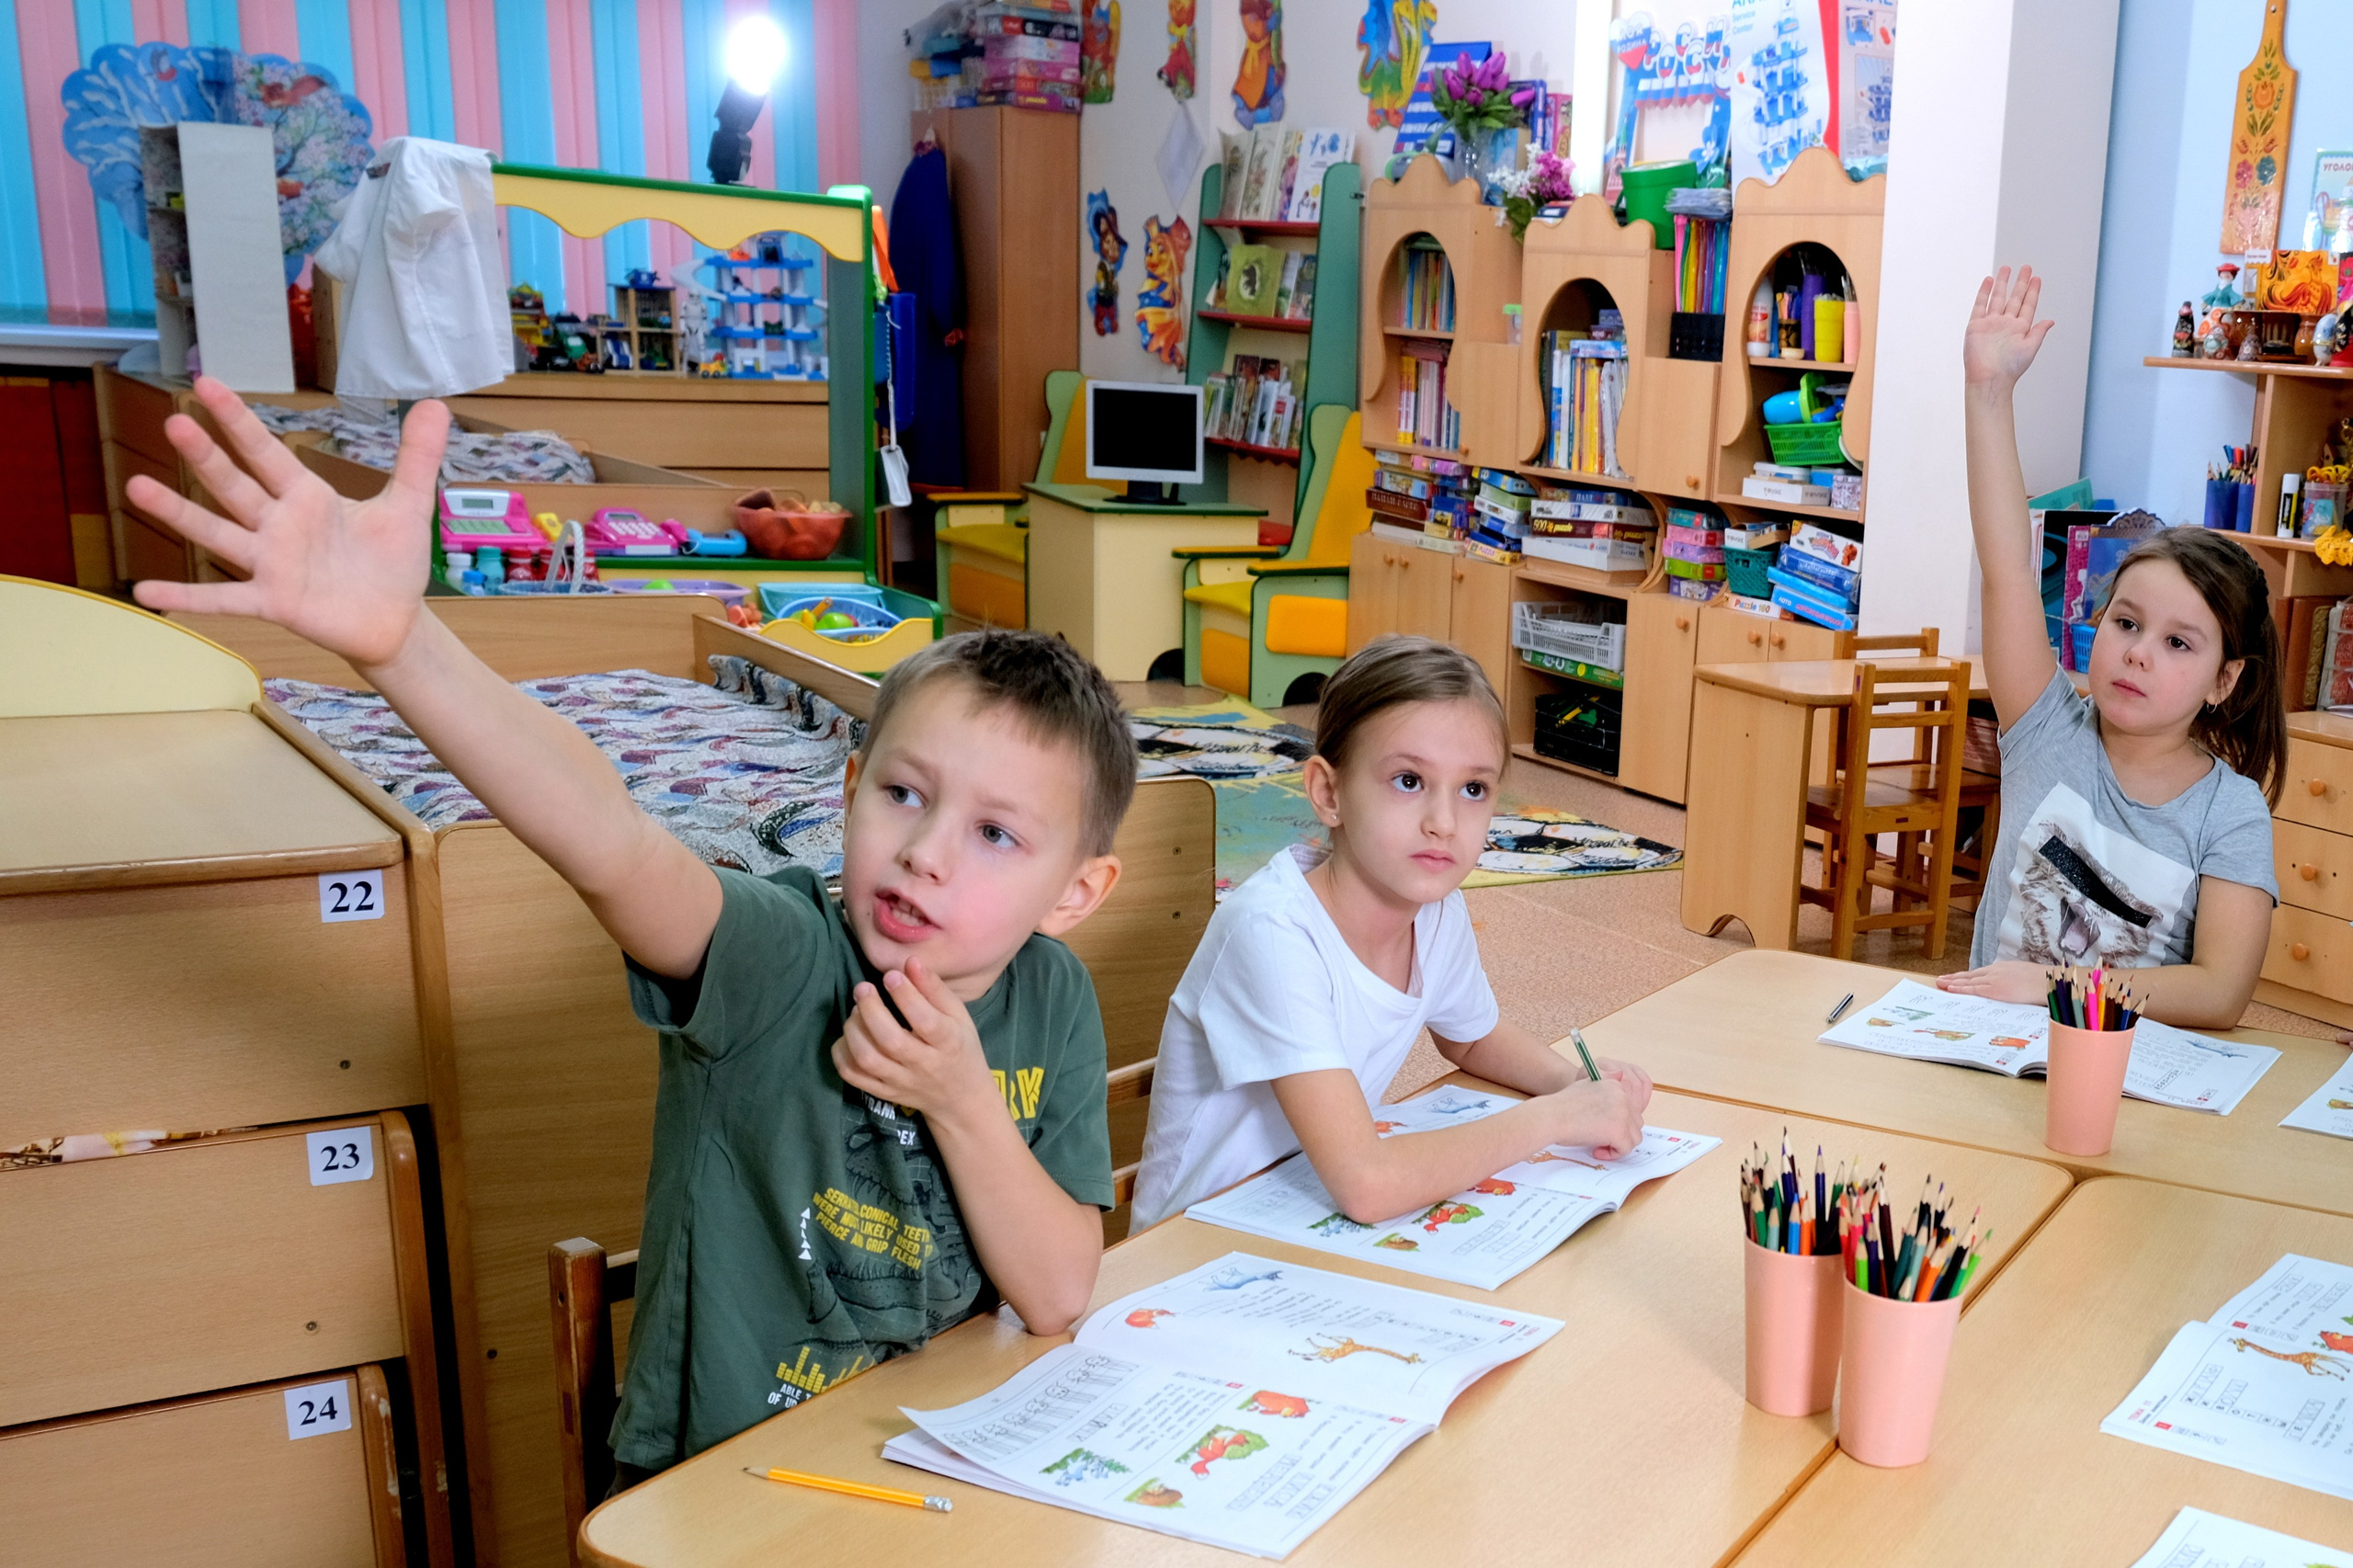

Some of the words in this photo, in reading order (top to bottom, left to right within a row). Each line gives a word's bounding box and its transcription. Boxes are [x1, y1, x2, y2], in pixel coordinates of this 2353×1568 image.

[2323, 163, 2353, 172] УГОЛО
[1533, 519, 1547, 531] 500
[1553, 522, 1573, 533] puzzle
[1733, 598, 1756, 611] Puzzle
[328, 881, 374, 913] 22
[321, 1142, 360, 1172] 23
[813, 1192, 840, 1220] WERE
[860, 1220, 894, 1240] LIKELY
[896, 1234, 920, 1256] USED
[860, 1204, 899, 1231] CONICAL
[815, 1210, 850, 1241] PIERCE
[865, 1237, 889, 1254] GRIP
[891, 1246, 923, 1271] FLESH
[767, 1392, 782, 1405] OF
[779, 1383, 802, 1400] ABLE
[298, 1395, 338, 1426] 24
